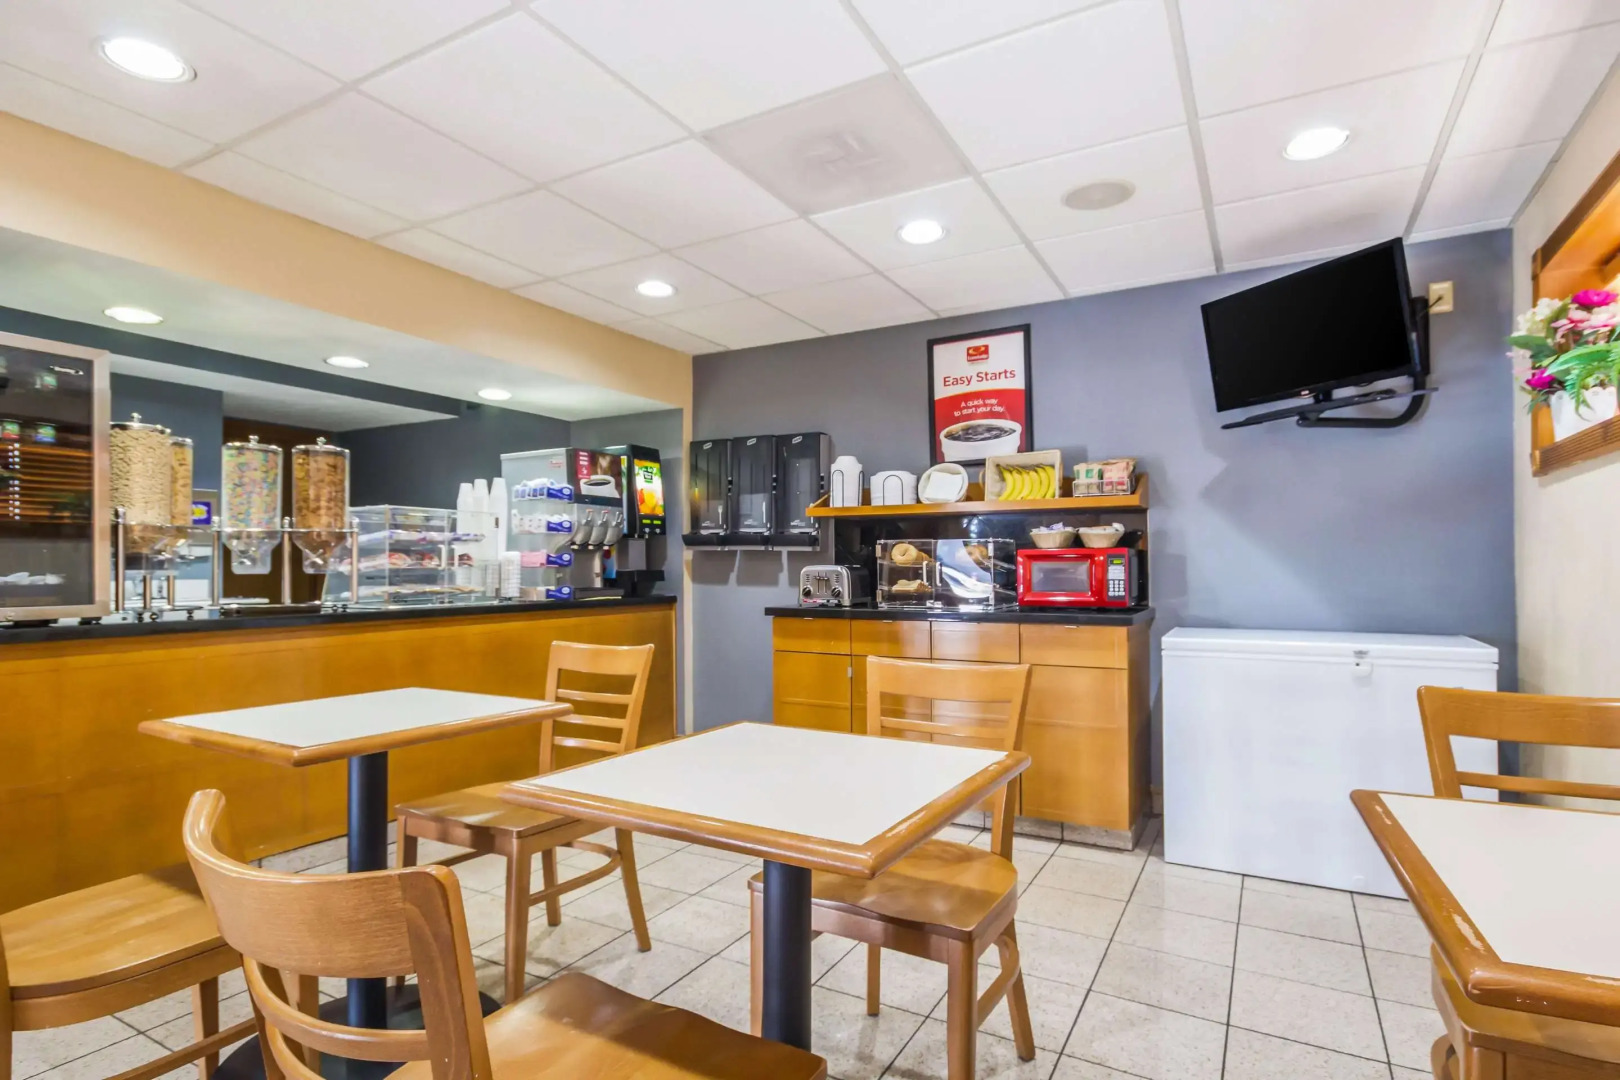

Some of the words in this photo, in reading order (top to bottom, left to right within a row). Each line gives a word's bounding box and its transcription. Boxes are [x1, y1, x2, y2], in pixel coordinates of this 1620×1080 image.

[943, 375, 973, 387] Easy
[976, 369, 1016, 382] Starts
[967, 399, 984, 407] quick
